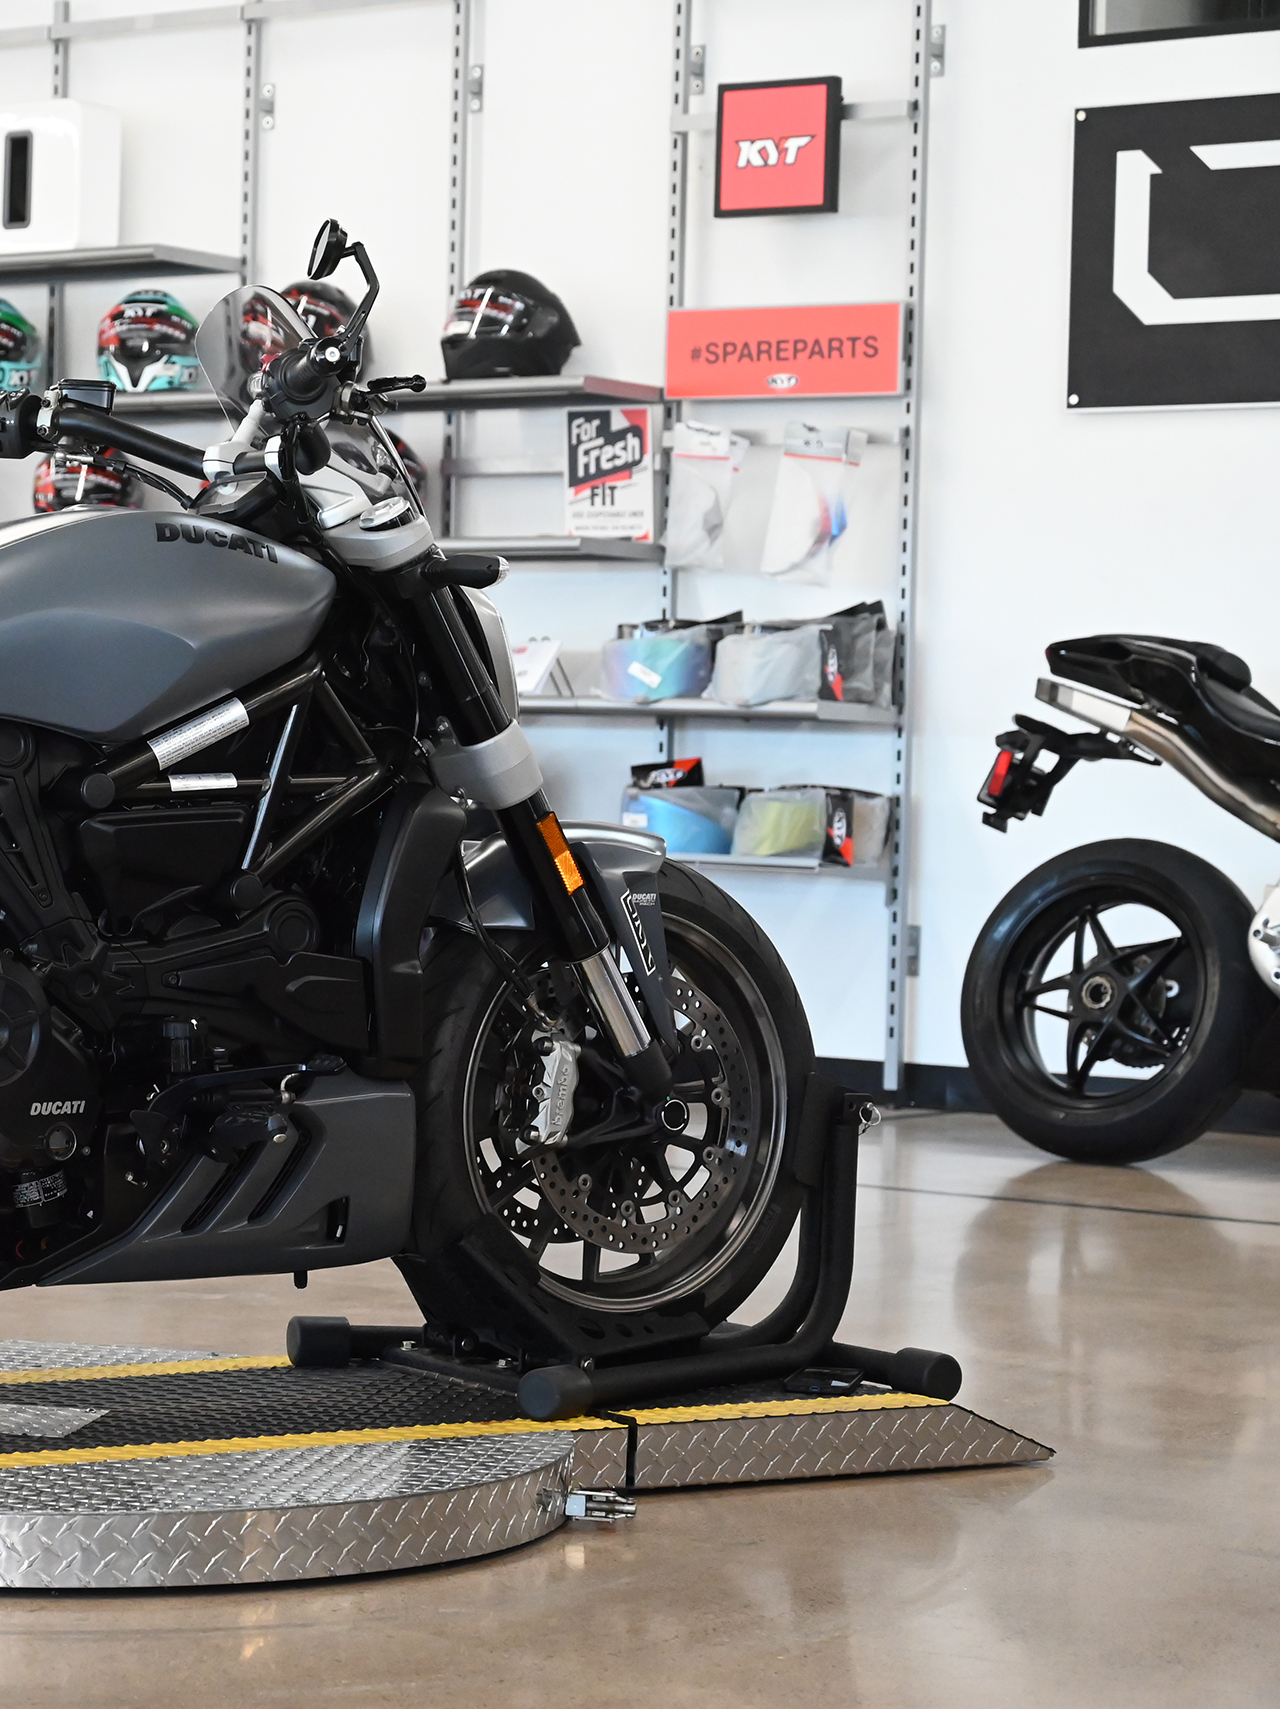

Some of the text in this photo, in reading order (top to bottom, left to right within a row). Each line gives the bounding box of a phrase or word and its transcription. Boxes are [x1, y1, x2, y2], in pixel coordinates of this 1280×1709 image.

[735, 135, 816, 168] KYT
[691, 335, 880, 364] #SPAREPARTS
[571, 417, 601, 445] For
[577, 432, 641, 478] Fresh
[590, 482, 618, 506] FIT
[155, 523, 278, 564] DUCATI
[30, 1100, 86, 1116] DUCATI
[550, 1066, 569, 1126] brembo
